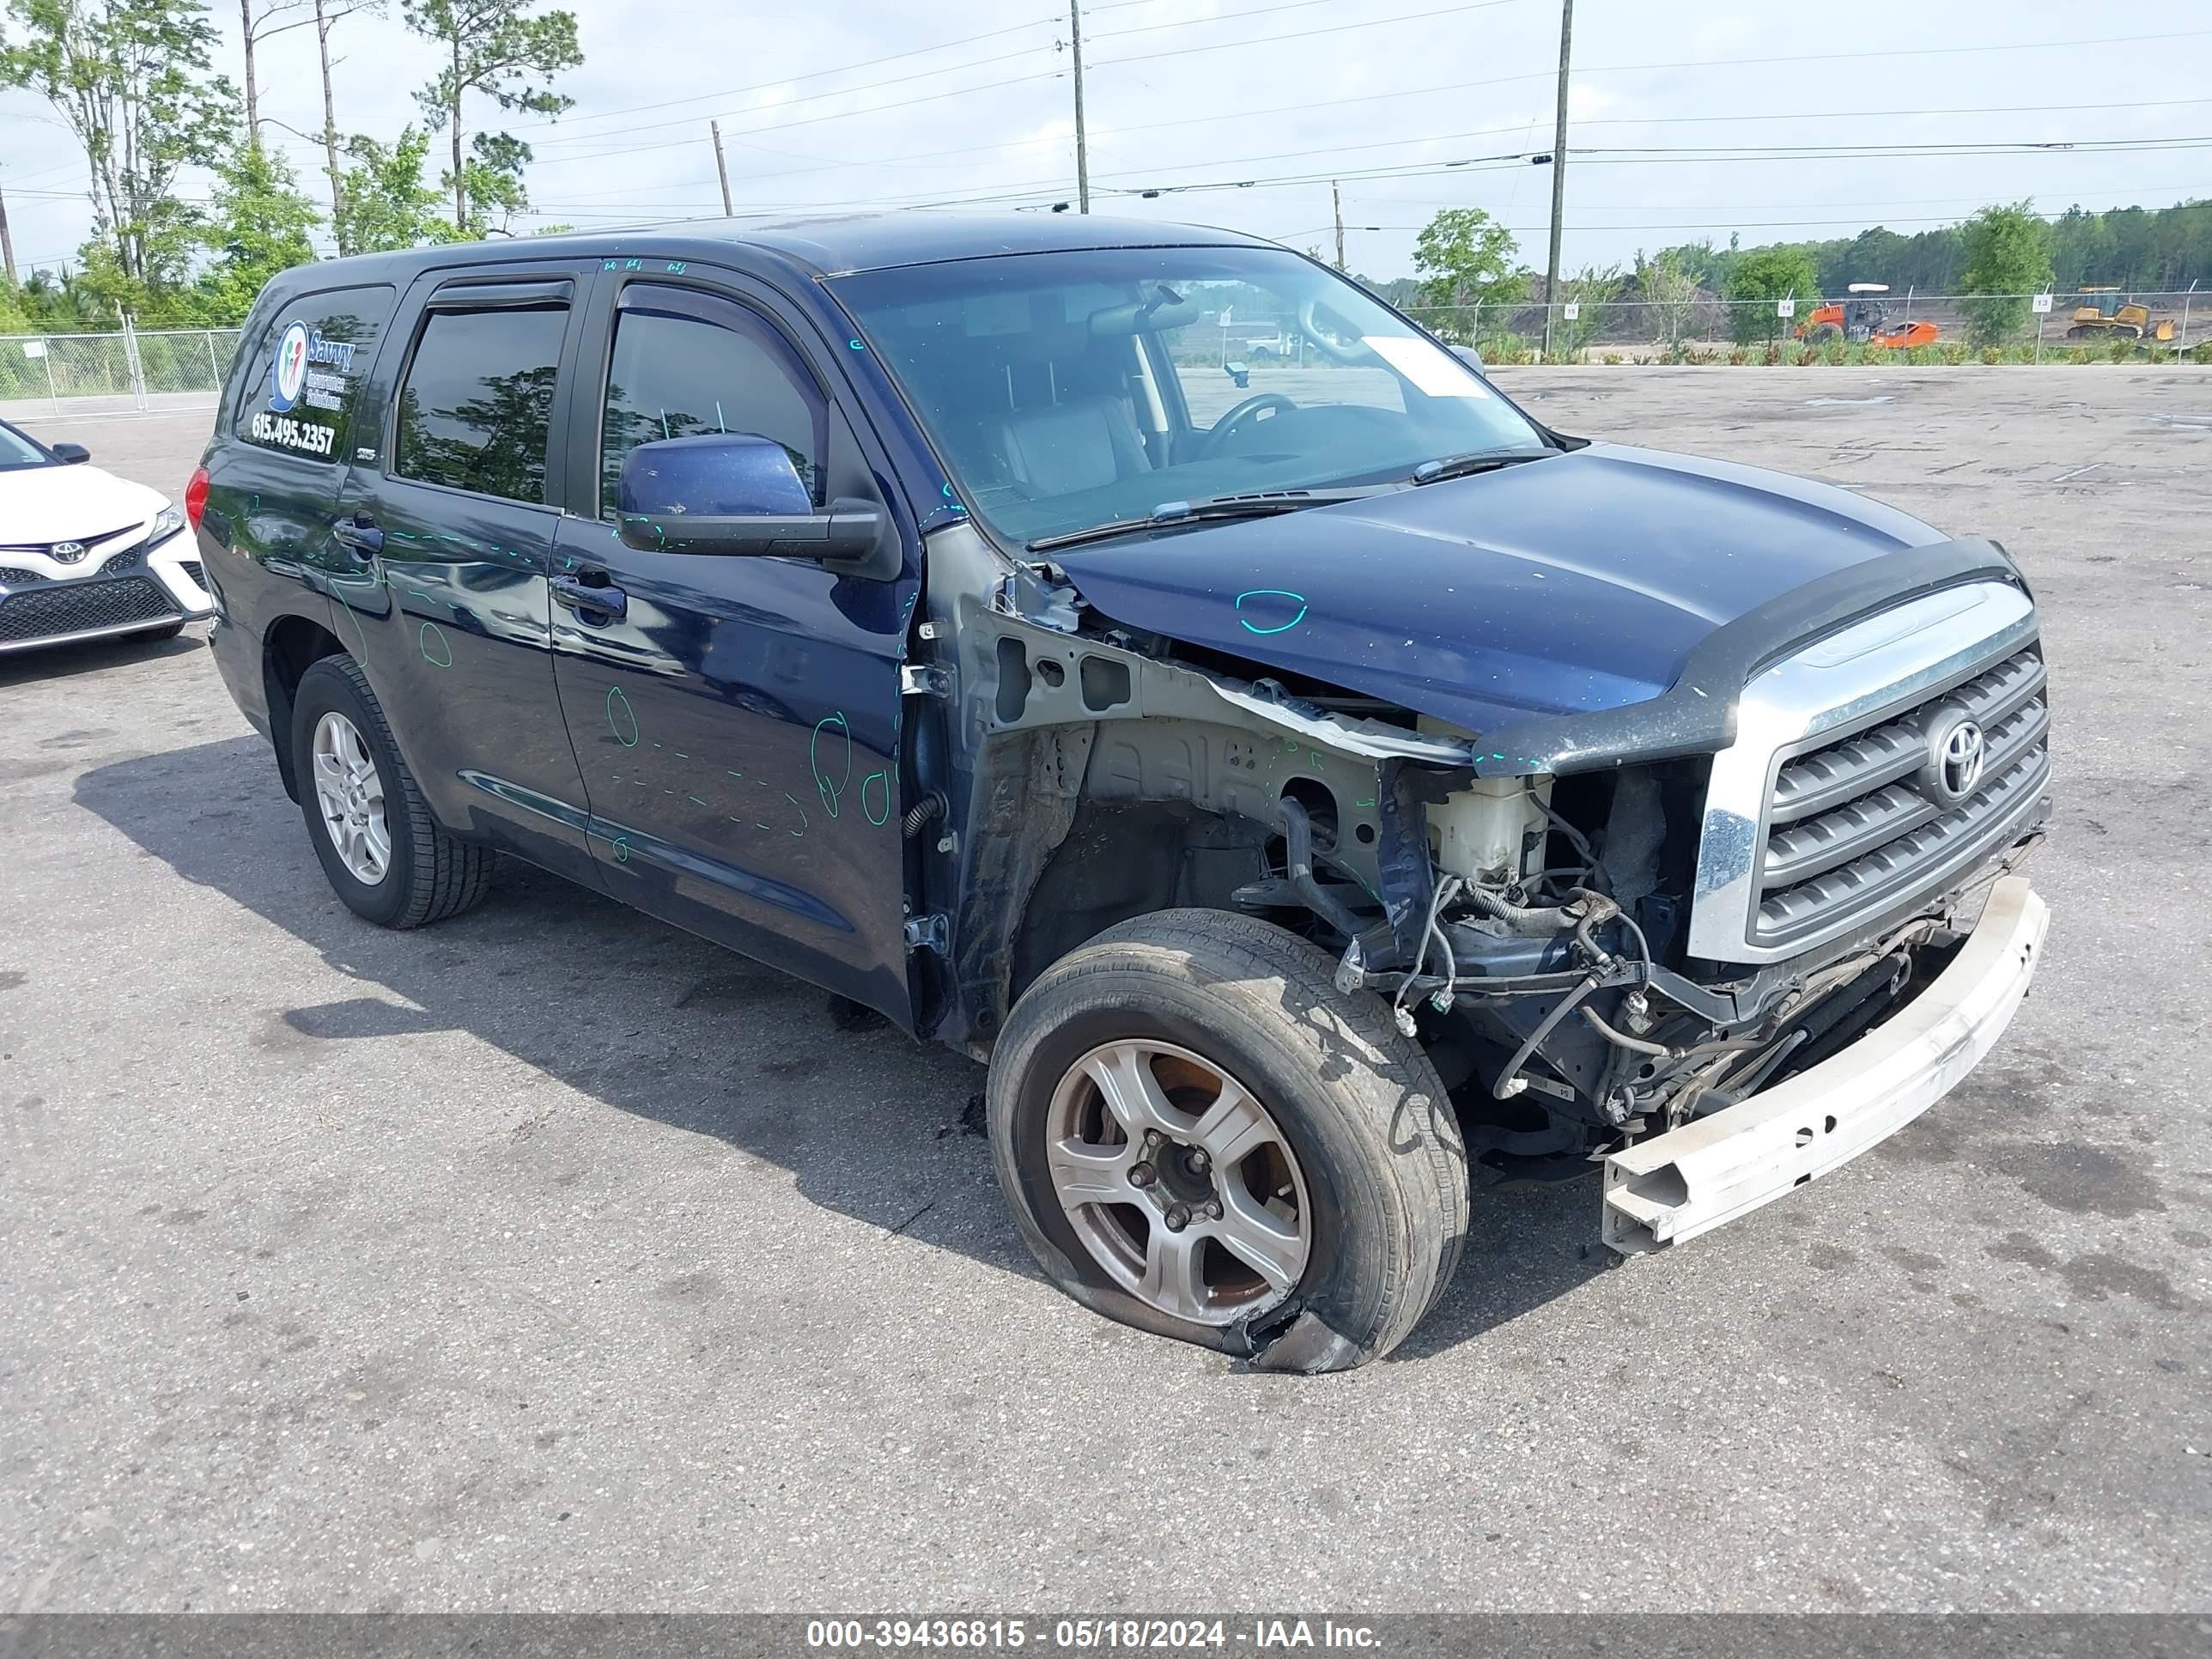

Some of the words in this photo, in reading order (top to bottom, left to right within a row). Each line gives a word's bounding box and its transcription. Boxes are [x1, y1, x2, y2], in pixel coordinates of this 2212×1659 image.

[307, 330, 356, 372] Savvy
[306, 370, 345, 392] Insurance
[306, 388, 342, 411] Solutions
[252, 412, 335, 455] 615.495.2357
